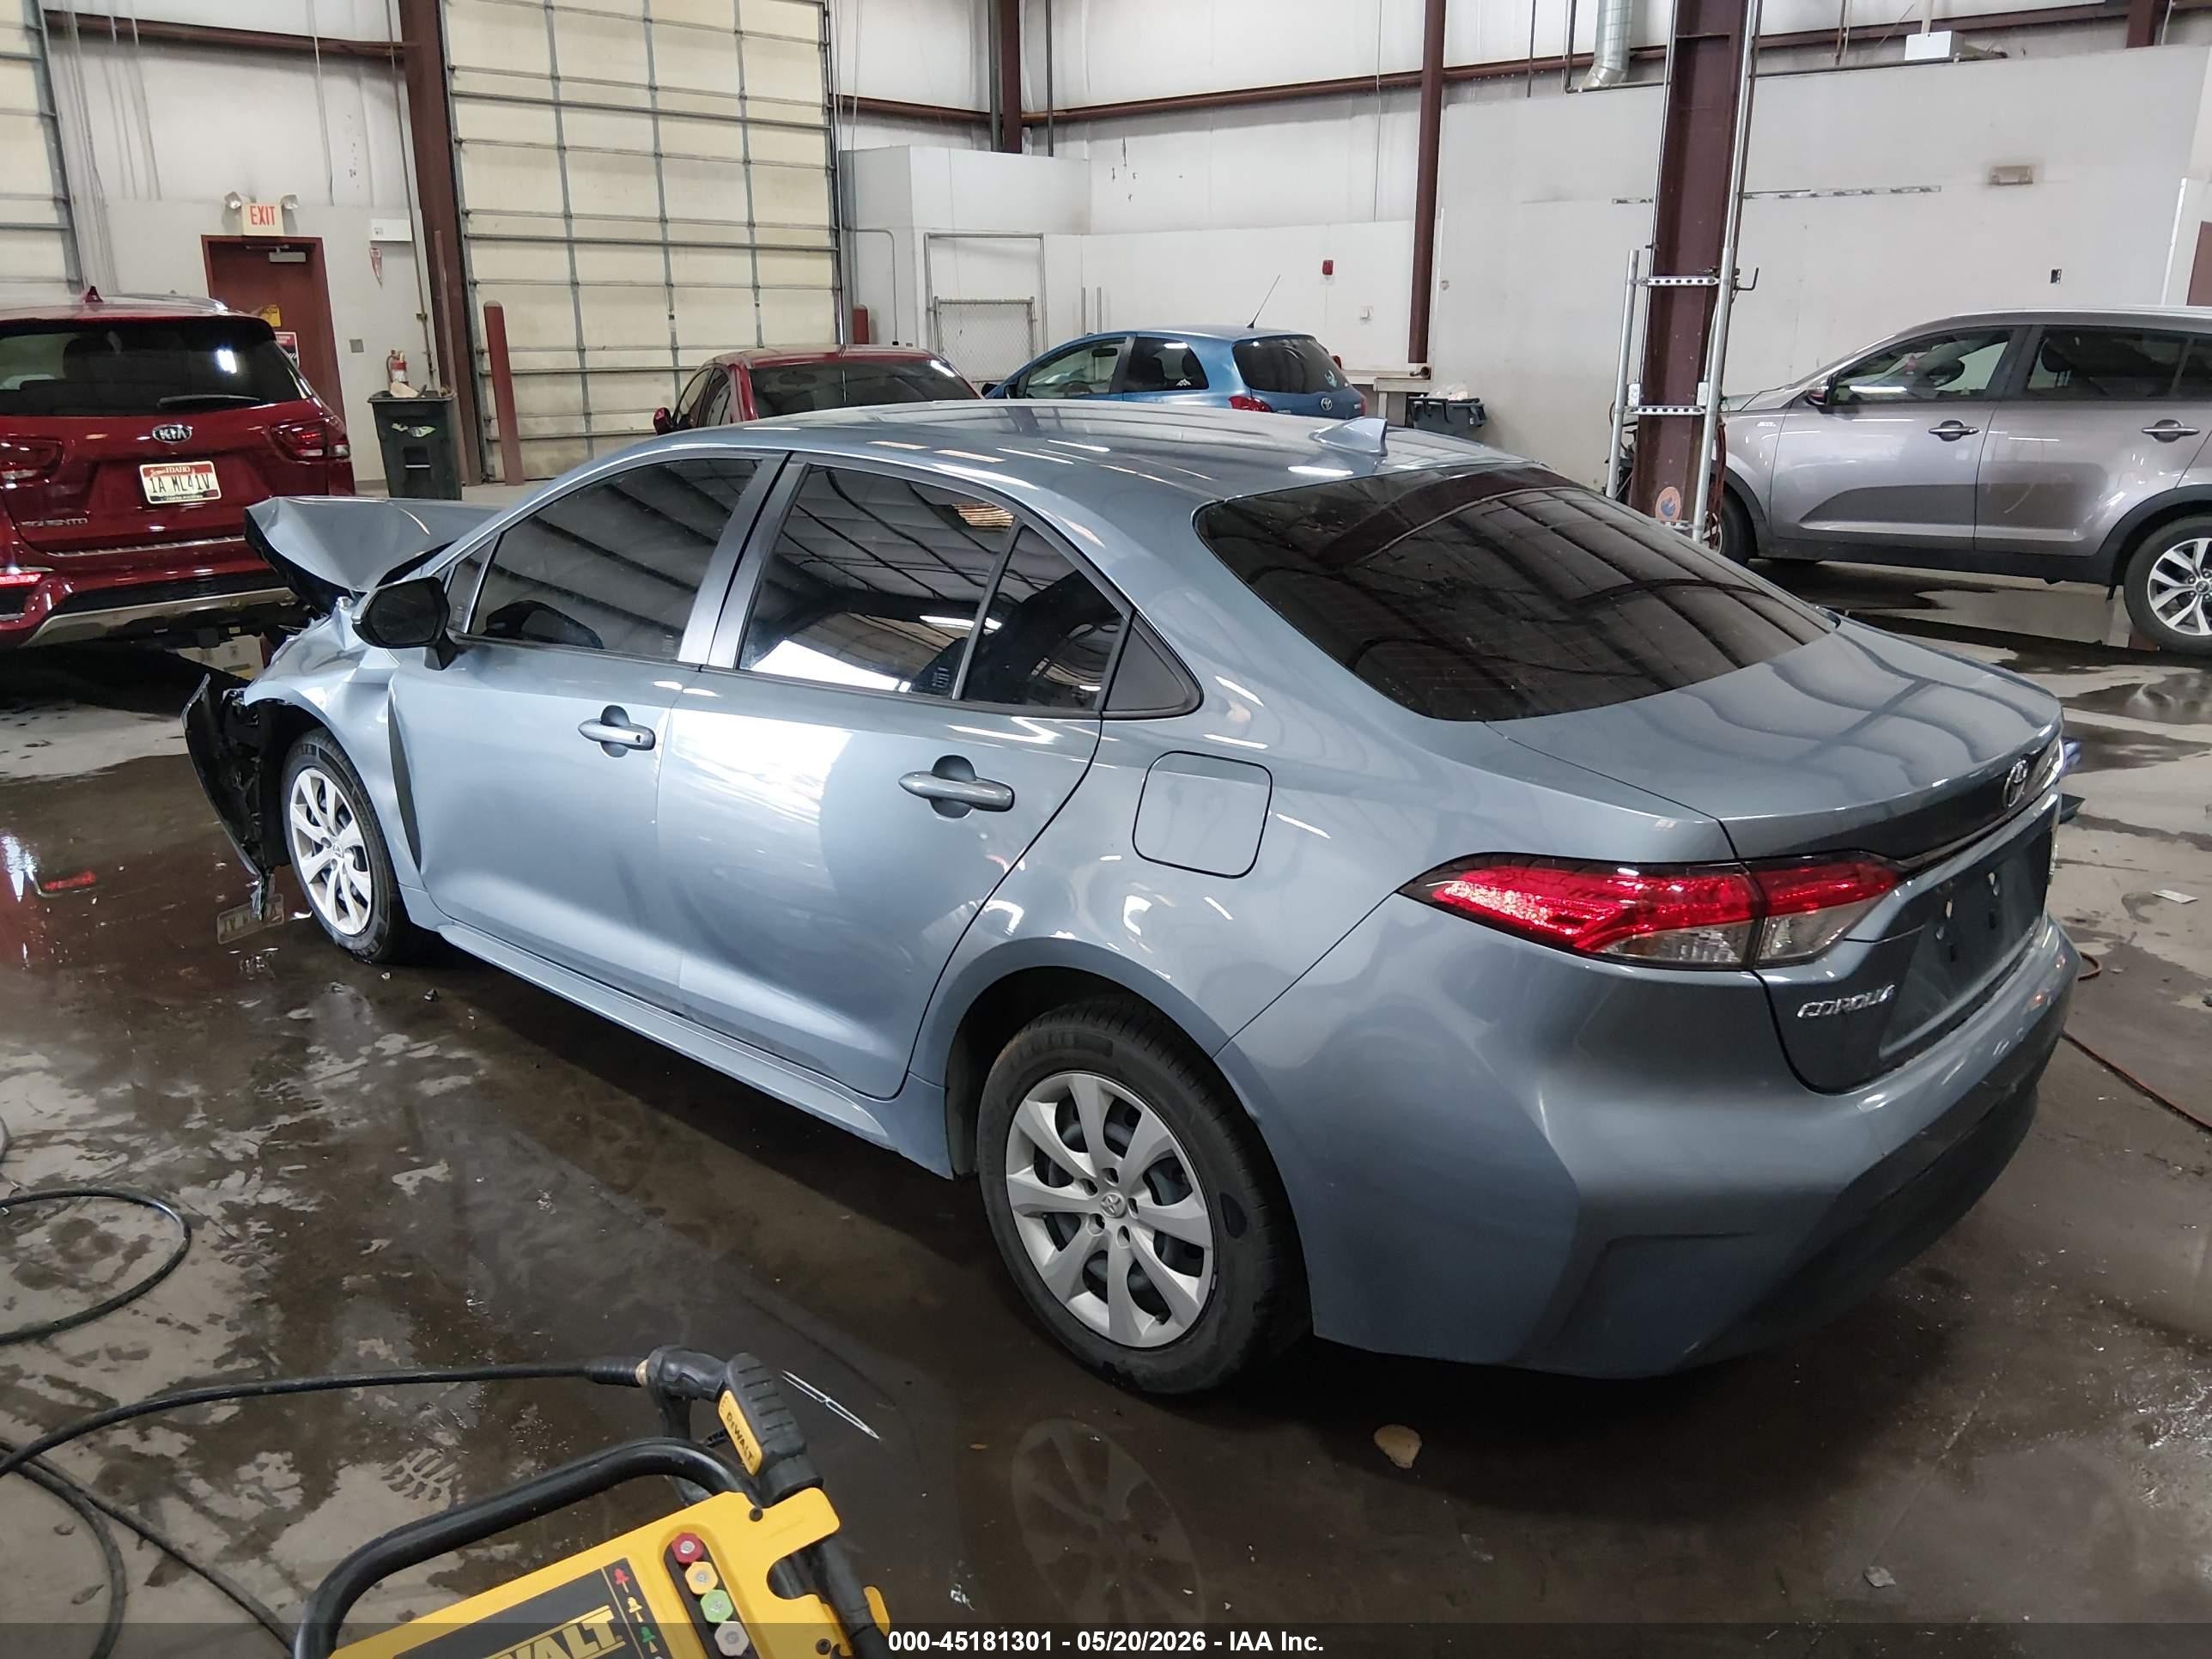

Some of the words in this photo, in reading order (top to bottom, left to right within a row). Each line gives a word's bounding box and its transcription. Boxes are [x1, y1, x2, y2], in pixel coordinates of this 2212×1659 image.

[250, 205, 276, 226] EXIT
[159, 428, 187, 440] KIA
[149, 477, 167, 493] 1A
